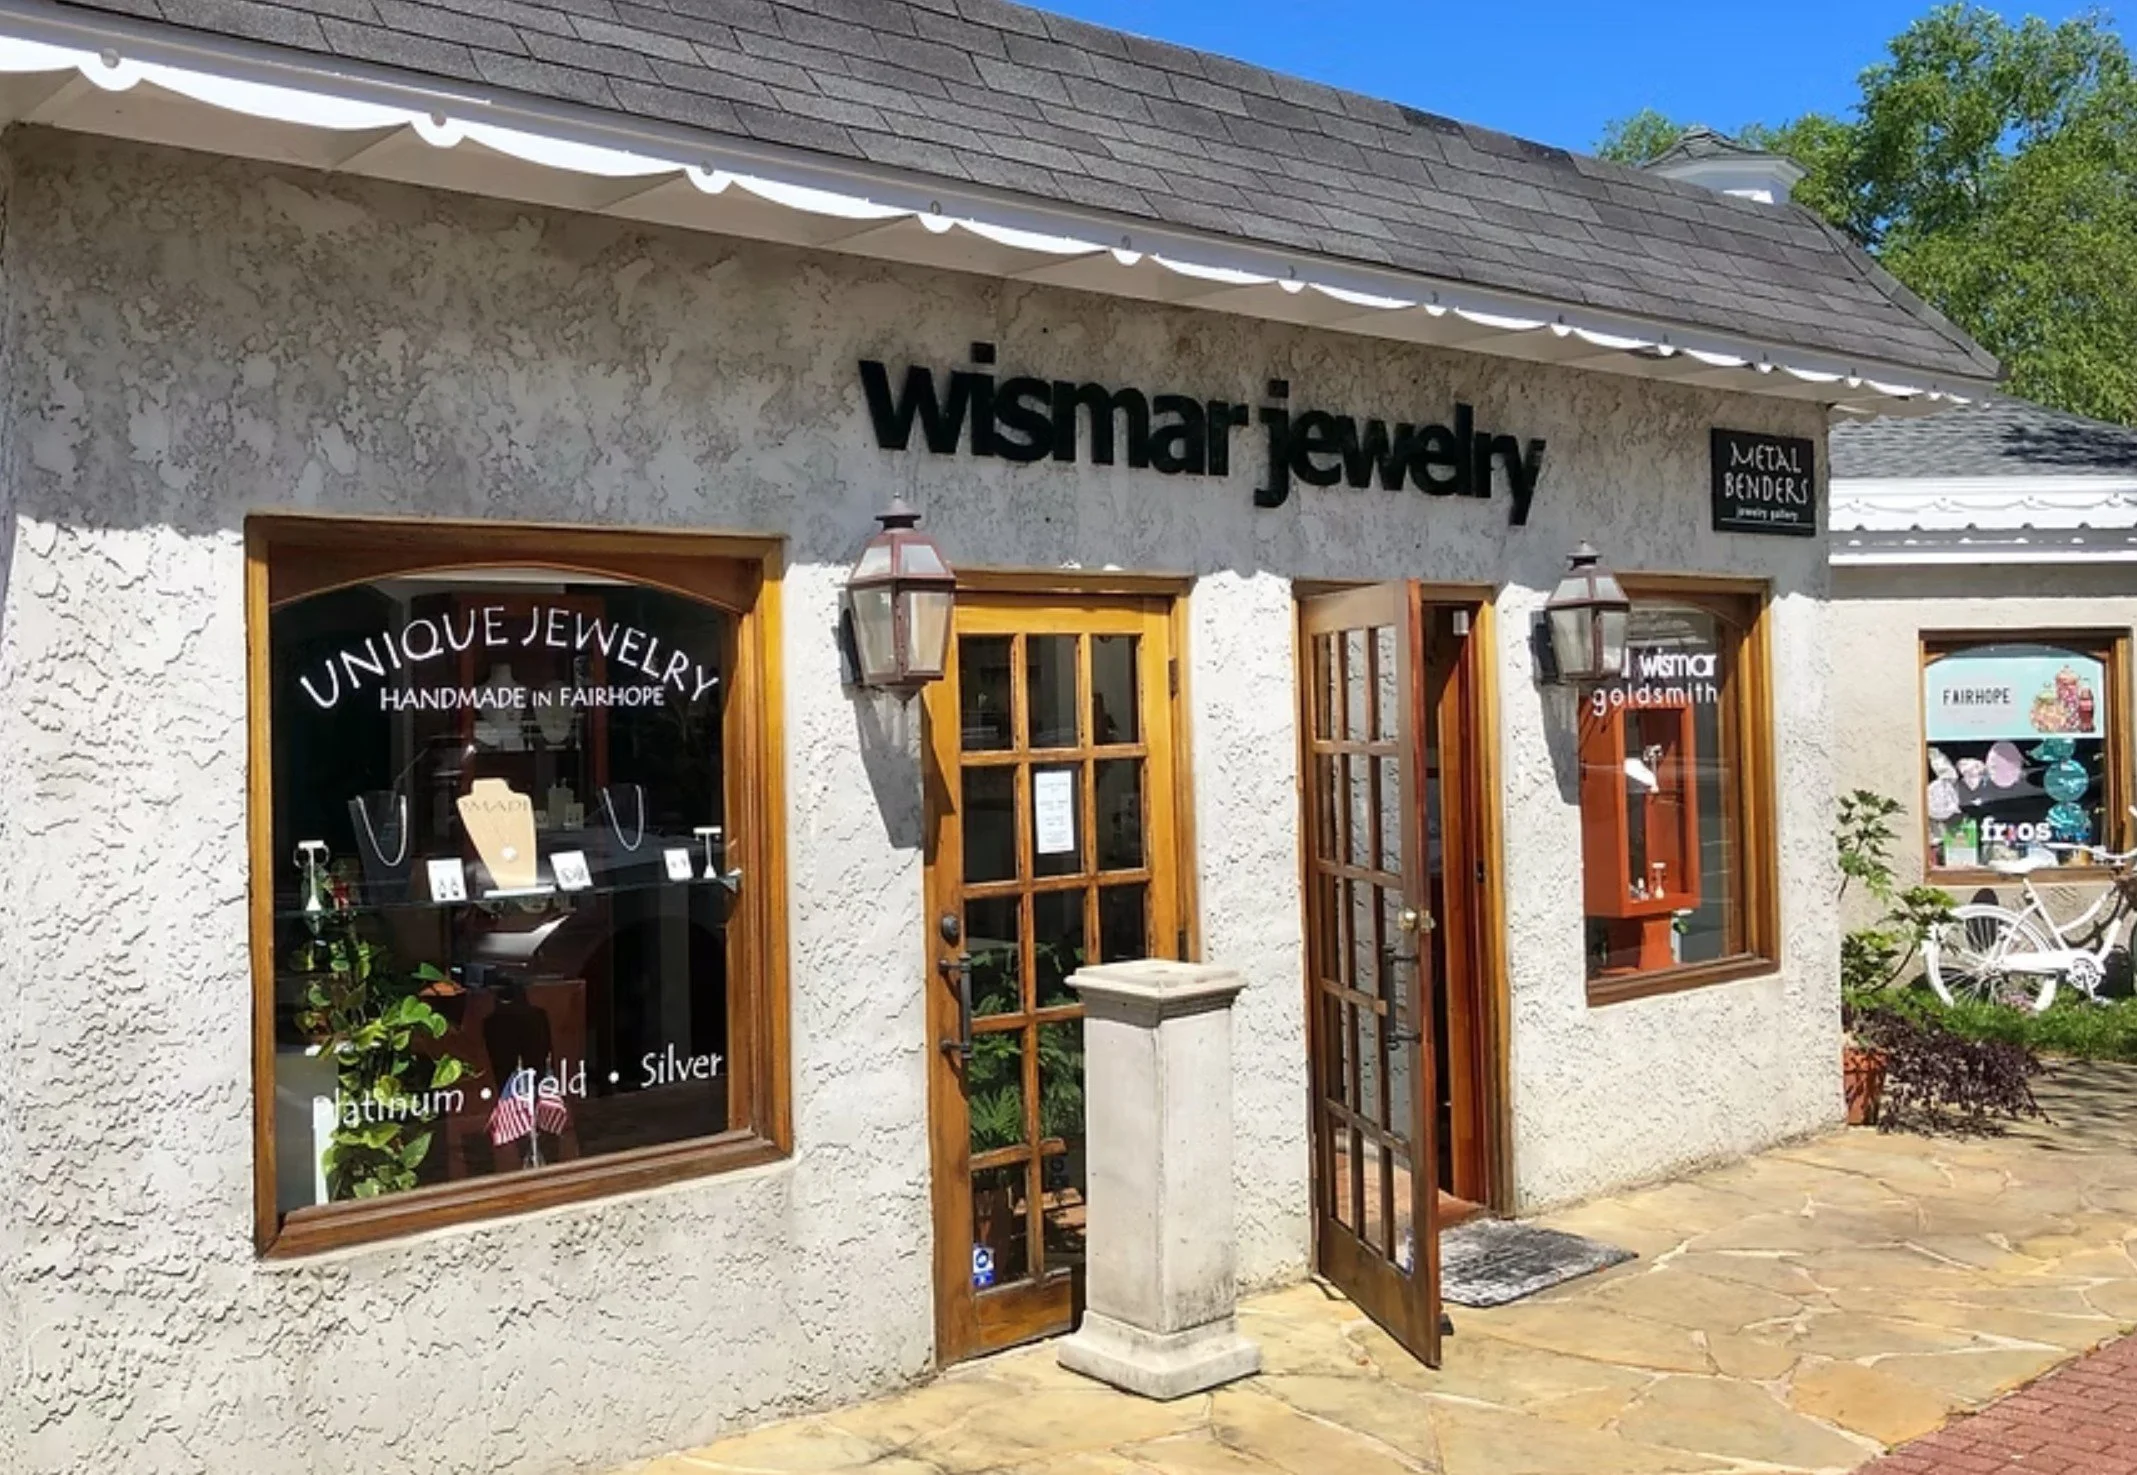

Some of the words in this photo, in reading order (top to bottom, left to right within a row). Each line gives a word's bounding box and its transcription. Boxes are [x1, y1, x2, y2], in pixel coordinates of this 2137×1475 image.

[858, 342, 1248, 478] wismar
[1253, 379, 1546, 526] jewelry
[1730, 441, 1802, 474] METAL
[1725, 472, 1809, 506] BENDERS
[300, 606, 508, 709] UNIQUE
[520, 606, 719, 703] JEWELRY
[1638, 648, 1717, 677] wismar
[380, 686, 527, 711] HANDMADE
[532, 690, 553, 706] IN
[560, 686, 665, 707] FAIRHOPE
[1592, 682, 1718, 716] goldsmith
[1942, 687, 2011, 705] FAIRHOPE
[640, 1043, 723, 1088] Silver
